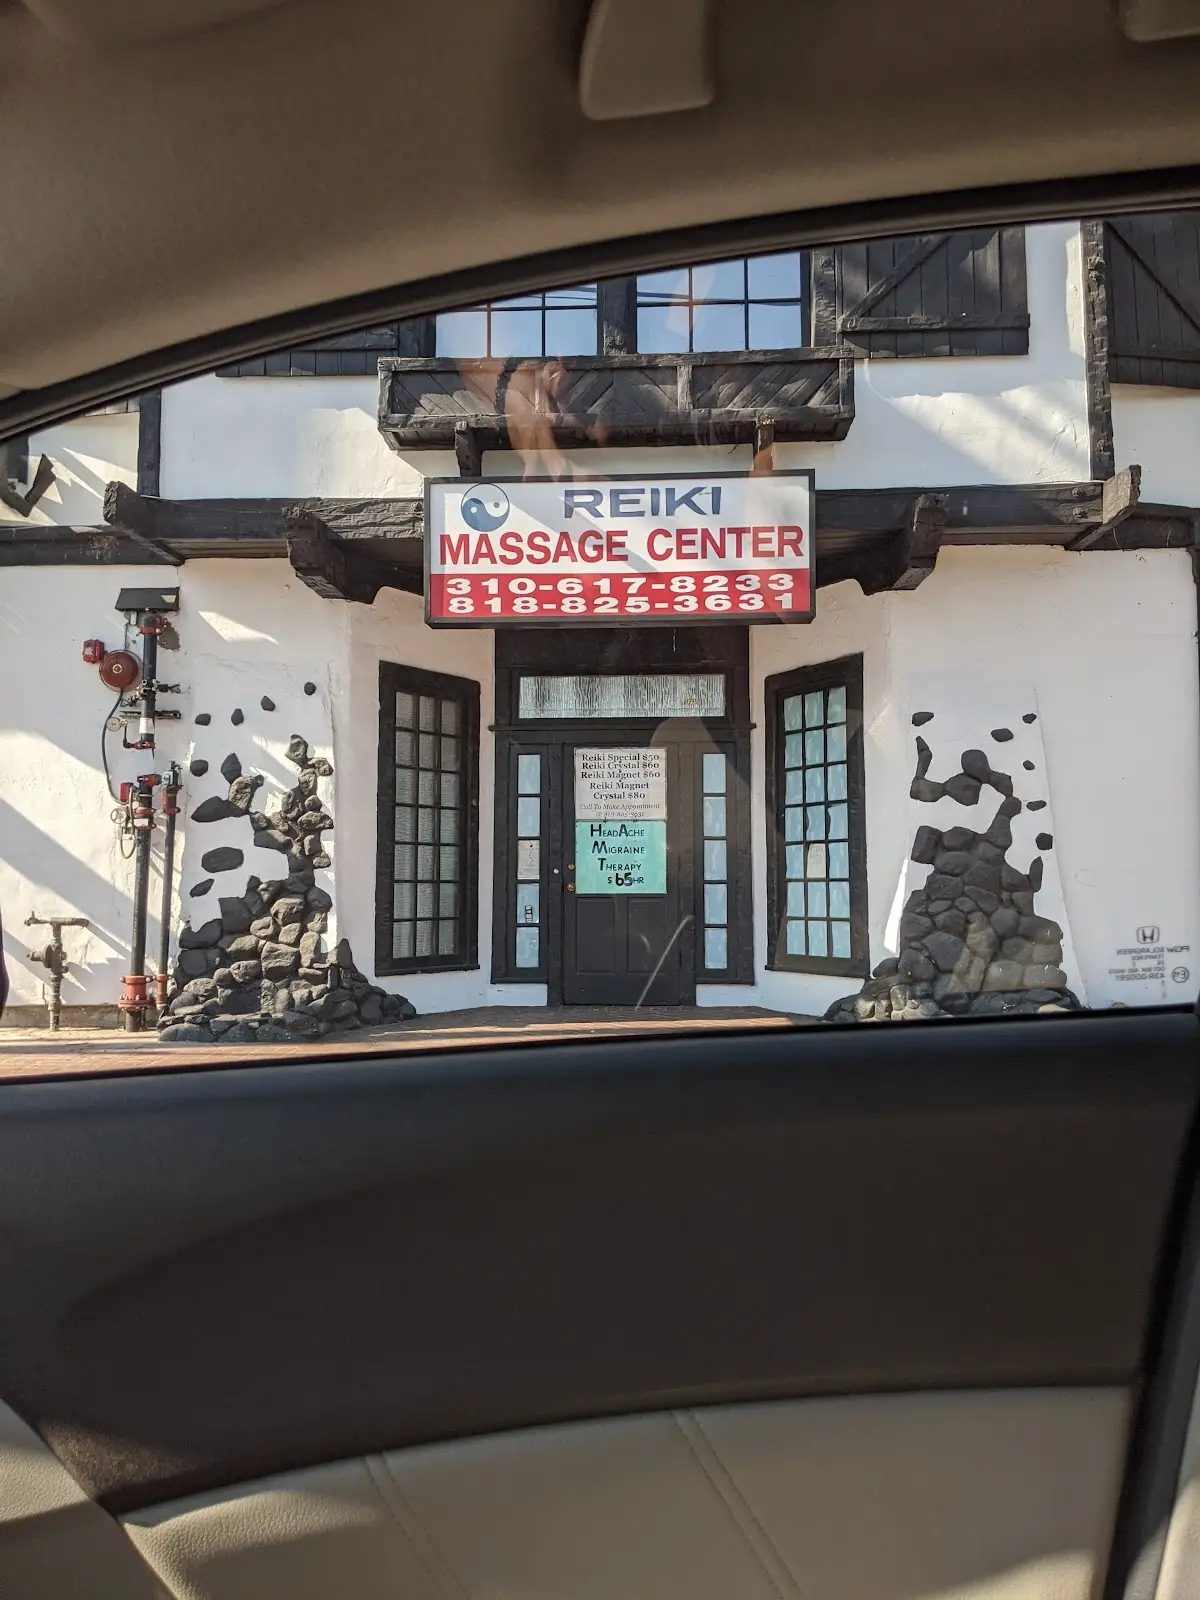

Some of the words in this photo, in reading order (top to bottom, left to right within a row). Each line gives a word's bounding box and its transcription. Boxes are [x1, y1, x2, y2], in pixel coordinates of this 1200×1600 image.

[564, 487, 722, 519] REIKI
[440, 530, 629, 566] MASSAGE
[646, 525, 804, 562] CENTER
[446, 574, 794, 595] 310-617-8233
[447, 593, 793, 614] 818-825-3631
[582, 753, 605, 761] Reiki
[607, 753, 640, 763] Special
[642, 753, 660, 762] $50
[607, 761, 640, 771] Crystal
[607, 771, 641, 780] Magnet
[643, 771, 661, 779] $60
[615, 782, 649, 790] Magnet
[593, 791, 625, 801] Crystal
[627, 791, 645, 800] $80
